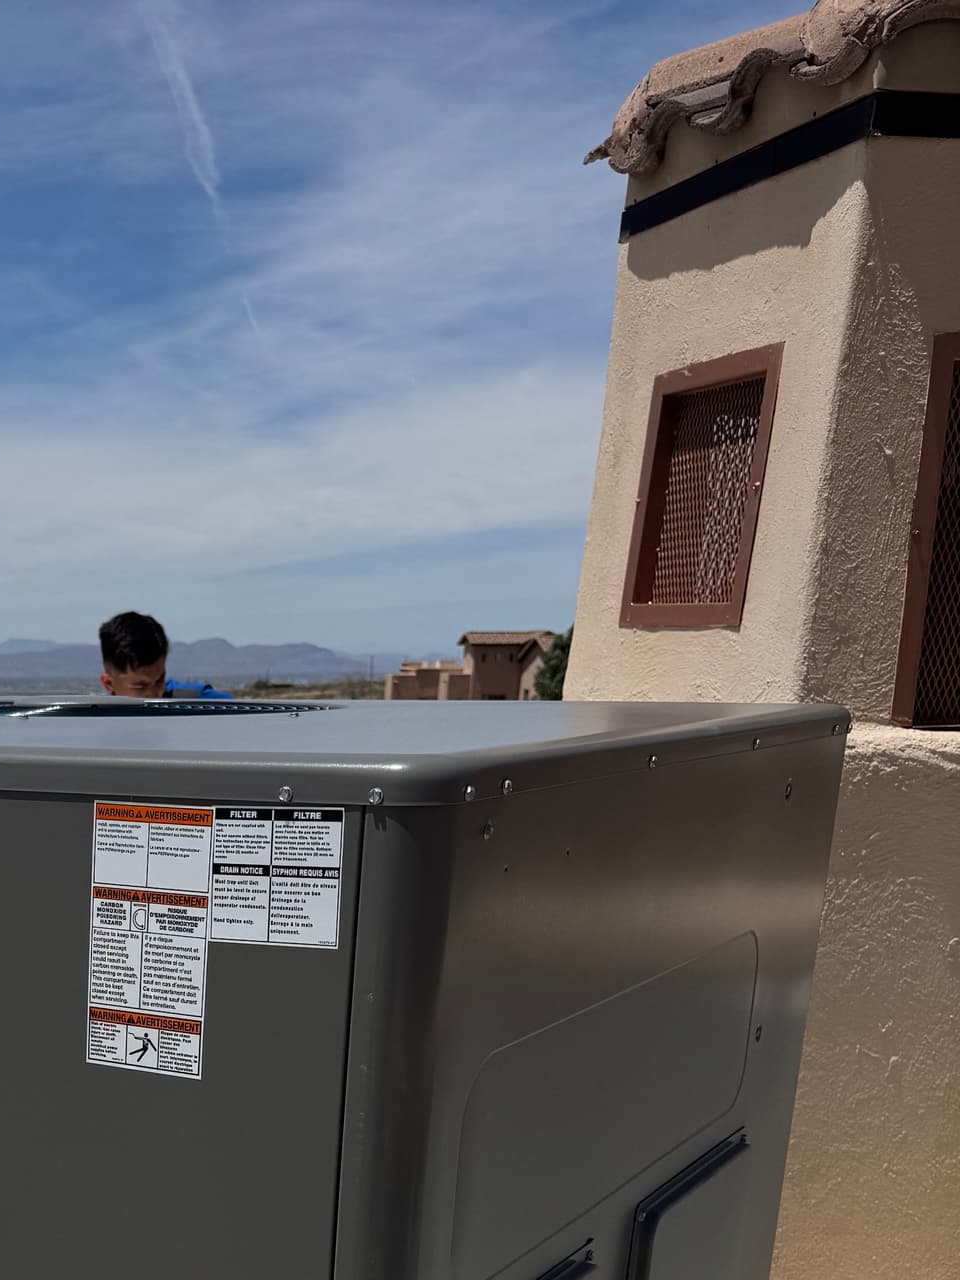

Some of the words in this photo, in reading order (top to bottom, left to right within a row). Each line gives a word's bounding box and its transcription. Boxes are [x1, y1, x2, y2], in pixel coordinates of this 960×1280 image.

[98, 807, 134, 818] WARNING
[145, 811, 210, 823] AVERTISSEMENT
[230, 810, 257, 818] FILTER
[293, 812, 322, 820] FILTRE
[220, 865, 239, 874] DRAIN
[240, 866, 264, 875] NOTICE
[272, 867, 297, 876] SYPHON
[299, 869, 323, 877] REQUIS
[324, 870, 339, 878] AVIS
[94, 887, 132, 900] WARNING
[142, 892, 207, 907] AVERTISSEMENT
[96, 906, 127, 914] MONOXIDE
[96, 912, 127, 921] POISONING
[167, 919, 199, 928] MONOXYDE
[167, 926, 194, 934] CARBONE
[89, 1007, 127, 1023] WARNING
[136, 1016, 200, 1033] AVERTISSEMENT
